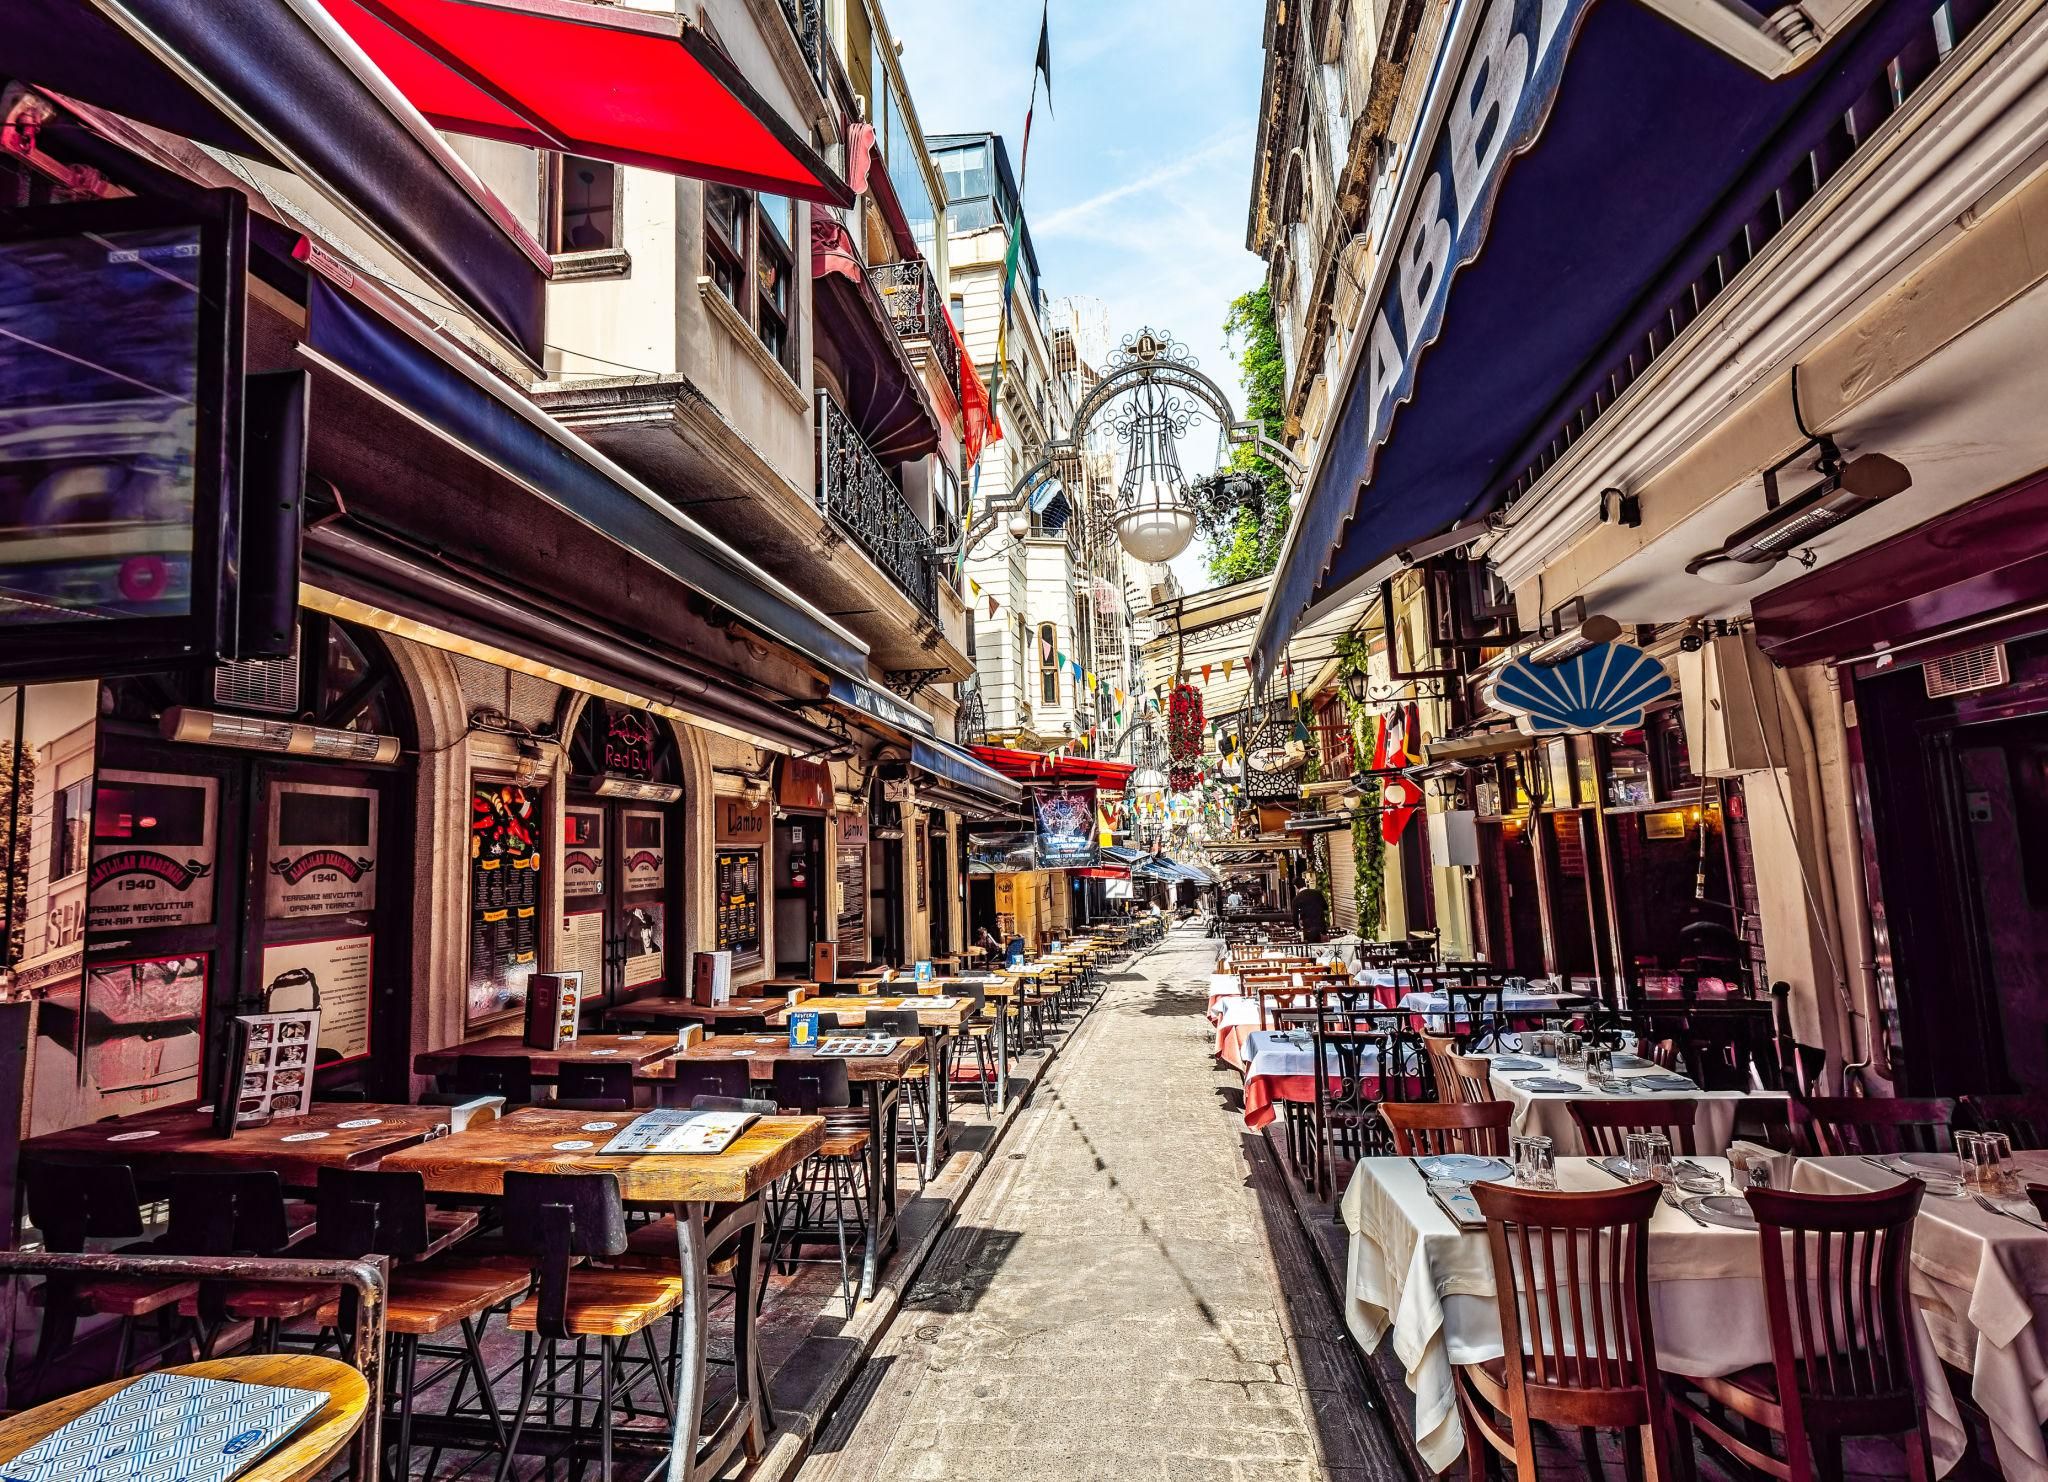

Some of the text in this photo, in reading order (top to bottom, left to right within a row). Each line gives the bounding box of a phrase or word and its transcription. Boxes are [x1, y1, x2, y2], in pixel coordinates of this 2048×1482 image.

[1368, 0, 1568, 446] ABB
[606, 744, 629, 769] Red
[728, 804, 762, 835] Lambo
[843, 815, 864, 839] Lambo
[312, 873, 337, 883] 1940
[118, 879, 156, 891] 1940
[596, 881, 603, 893] 9
[322, 891, 363, 900] MEVCUTTUR
[132, 901, 194, 913] MEVCUTTUR
[289, 901, 356, 912] OPEN-AIR TERRACE
[89, 914, 182, 928] PEN-AIR TERRACE
